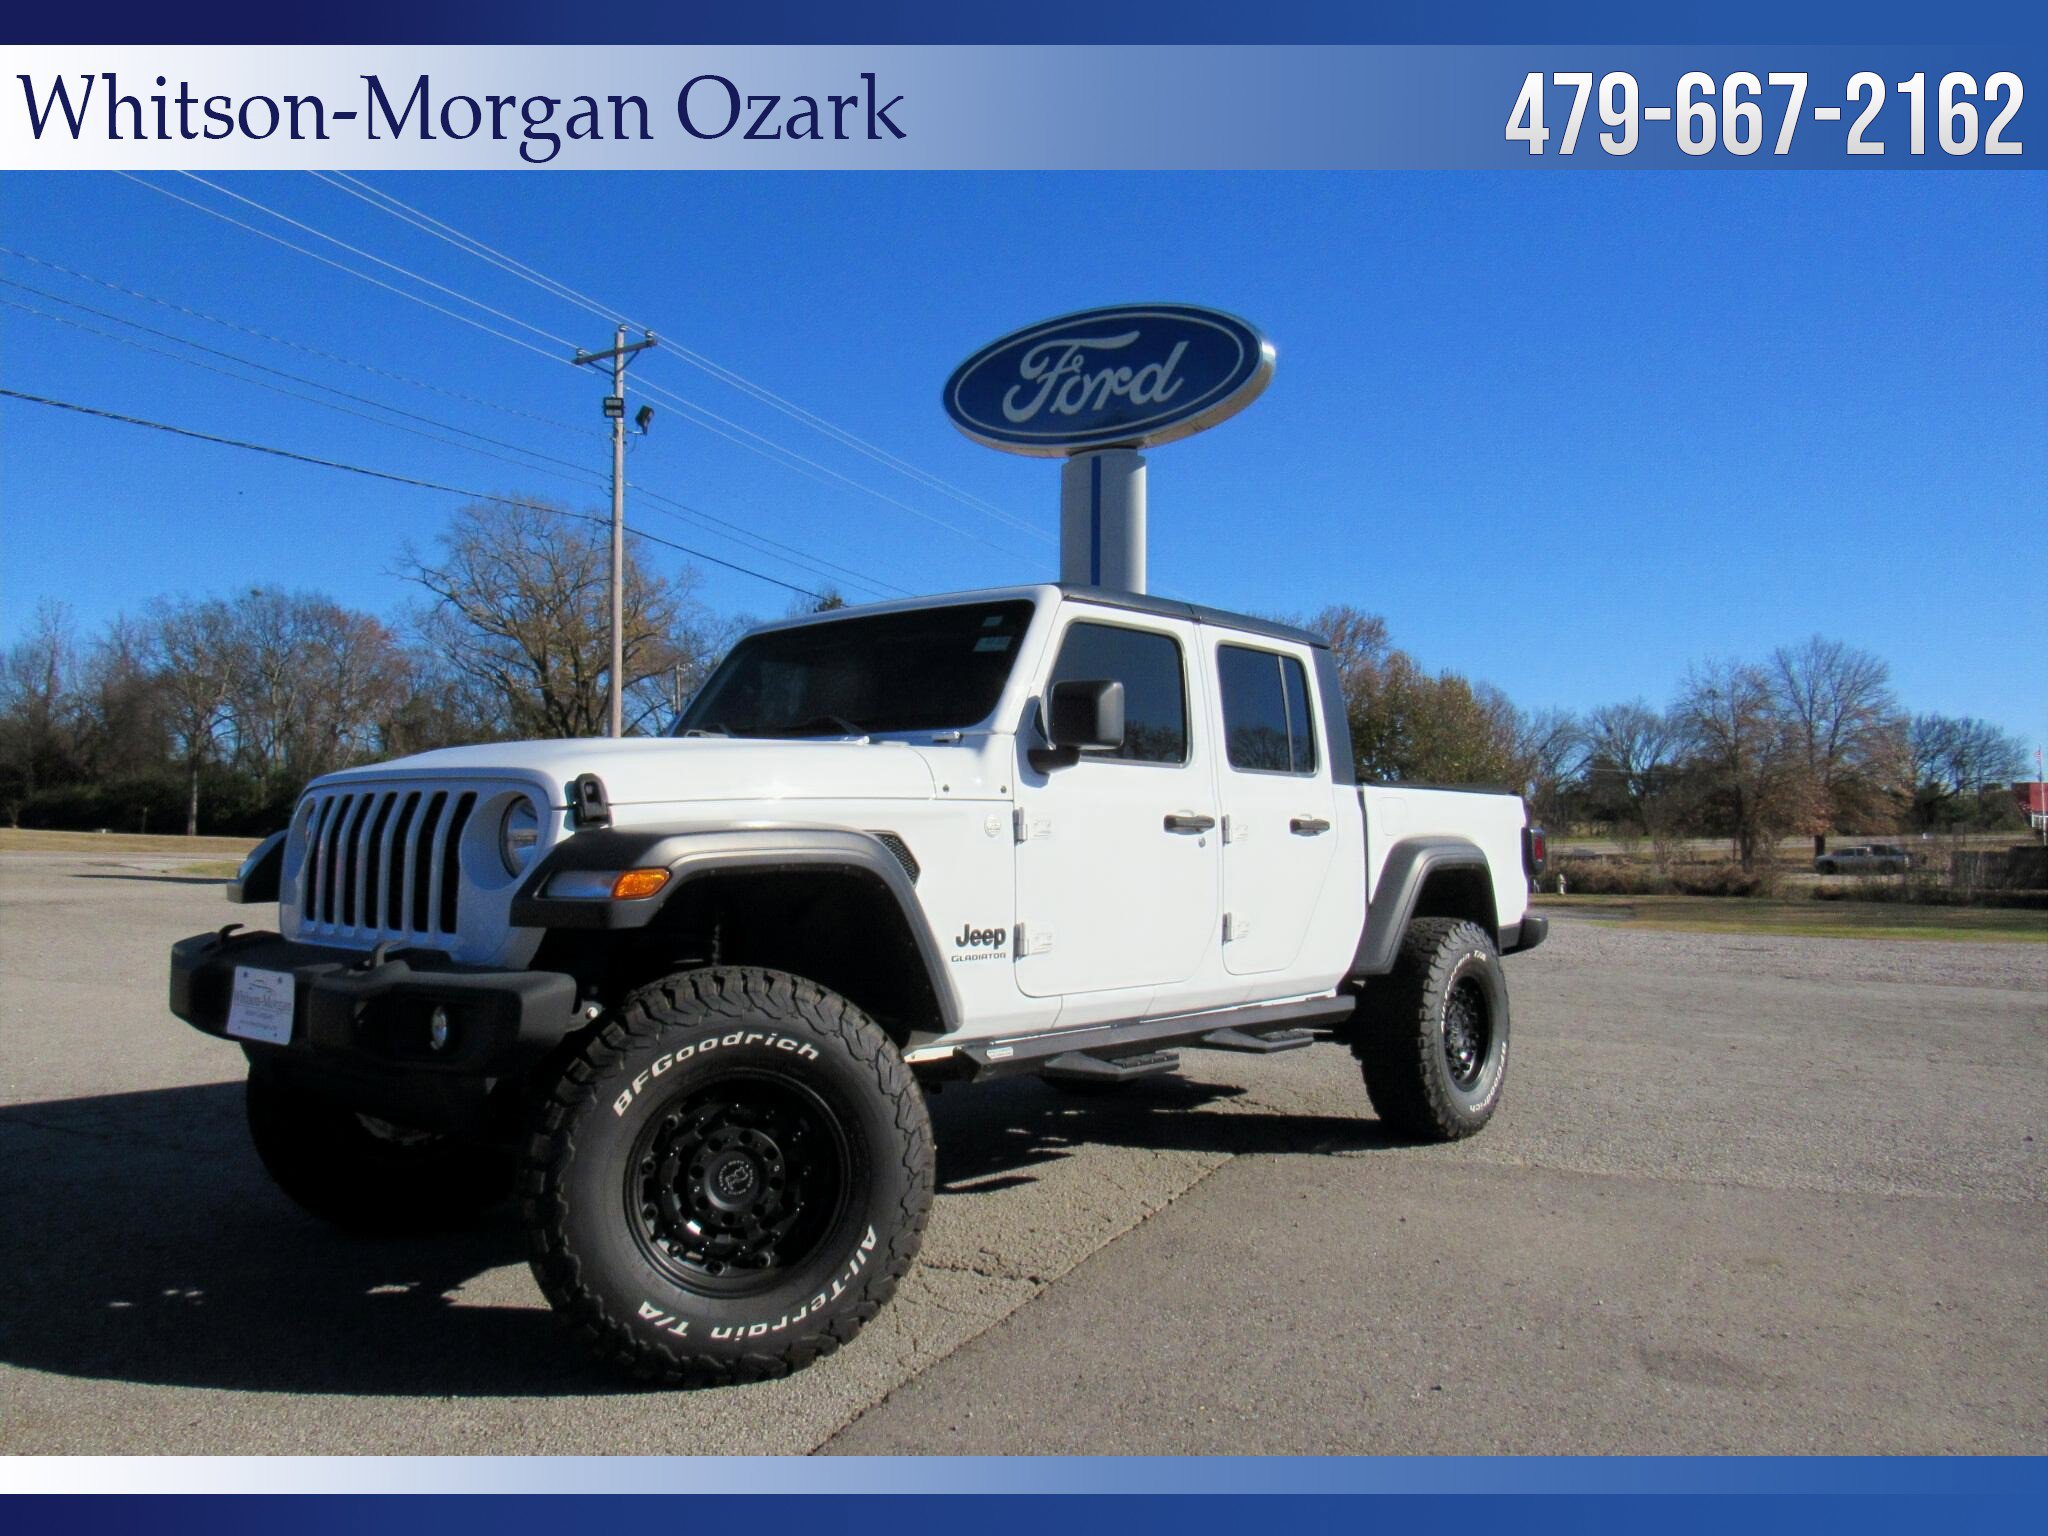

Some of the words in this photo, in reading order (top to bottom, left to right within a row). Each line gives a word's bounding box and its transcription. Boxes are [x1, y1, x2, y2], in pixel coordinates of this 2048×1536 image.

[1002, 331, 1190, 423] Ford
[955, 923, 1006, 949] Jeep
[613, 1031, 820, 1117] BFGoodrich
[637, 1300, 691, 1338] T/A
[710, 1224, 877, 1342] All-Terrain
